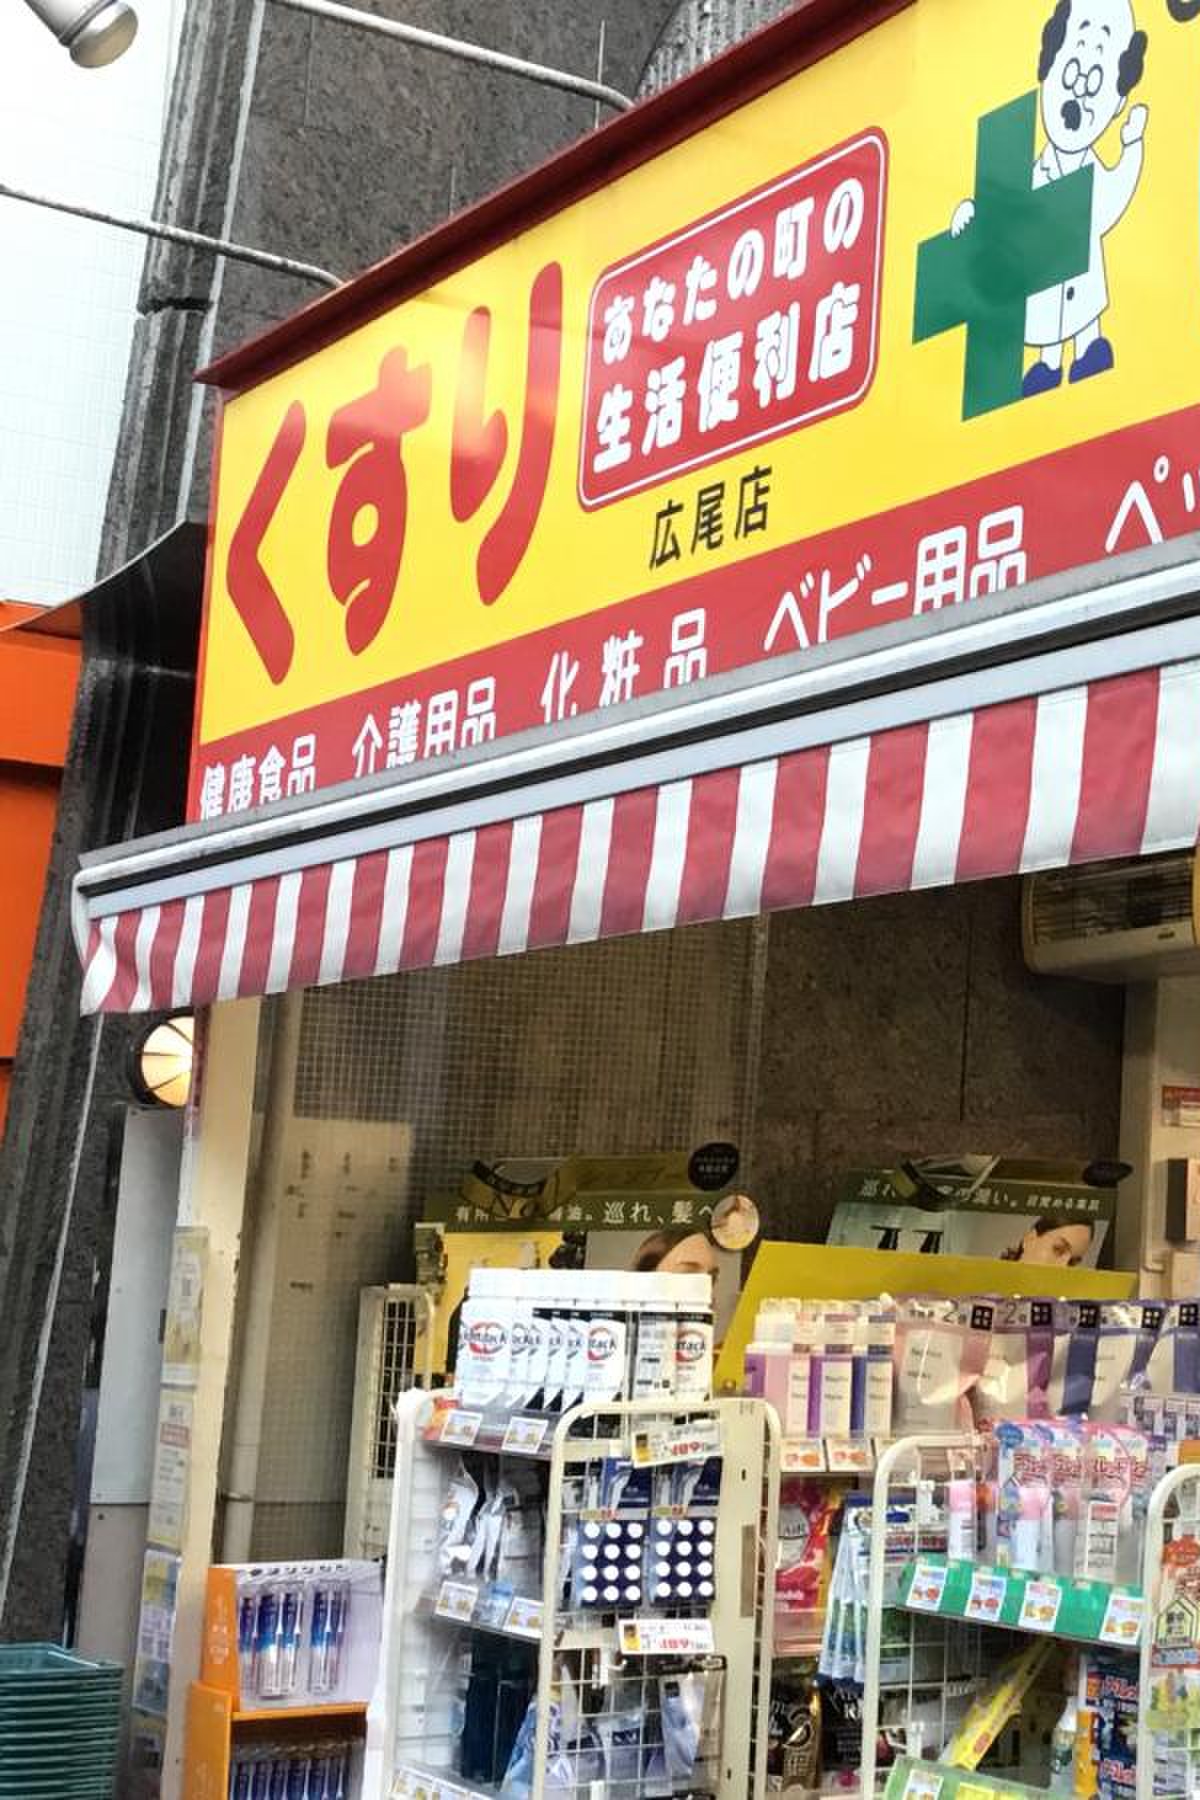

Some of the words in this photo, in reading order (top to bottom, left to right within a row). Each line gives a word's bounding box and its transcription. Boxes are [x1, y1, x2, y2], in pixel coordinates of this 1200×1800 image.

[603, 176, 866, 364] あなたの町の
[226, 261, 564, 686] くすり
[592, 281, 862, 474] 生活便利店
[648, 464, 773, 571] 広尾店
[200, 733, 317, 820] 健康食品
[351, 675, 497, 778] 介護用品
[540, 607, 706, 724] 化粧品
[763, 504, 1027, 652] ベビー用品
